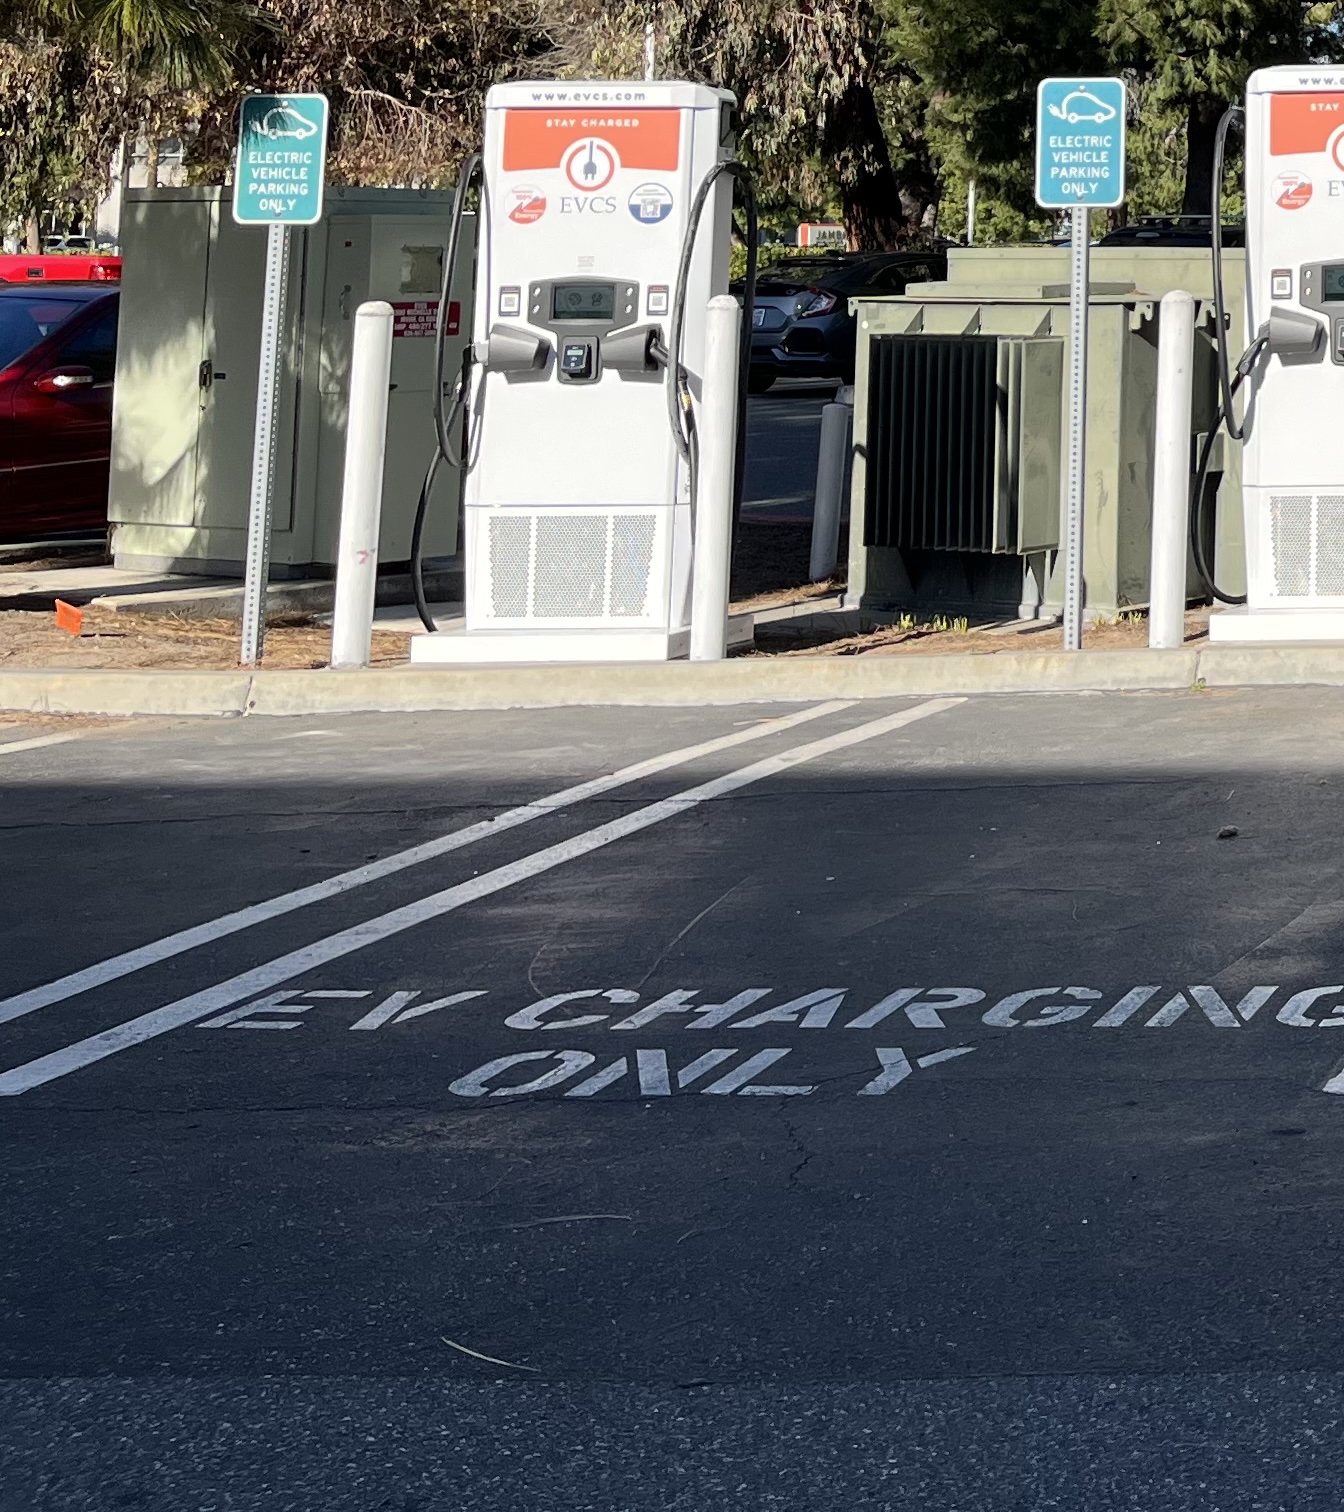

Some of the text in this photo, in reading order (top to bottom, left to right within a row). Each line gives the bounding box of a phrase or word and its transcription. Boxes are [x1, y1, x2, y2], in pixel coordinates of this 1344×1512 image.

[531, 92, 646, 101] www.evcs.com
[1310, 103, 1339, 111] STAY
[546, 118, 640, 127] STAY CHARGED
[1049, 135, 1112, 147] ELECTRIC
[248, 151, 312, 164] ELECTRIC
[1052, 151, 1109, 163] VEHICLE
[251, 167, 308, 179] VEHICLE
[1050, 166, 1110, 178] PARKING
[248, 182, 309, 195] PARKING
[1061, 182, 1098, 194] ONLY
[259, 198, 296, 210] ONLY
[560, 196, 617, 214] EVCS
[195, 989, 490, 1030] EV
[448, 1048, 978, 1098] ONLY
